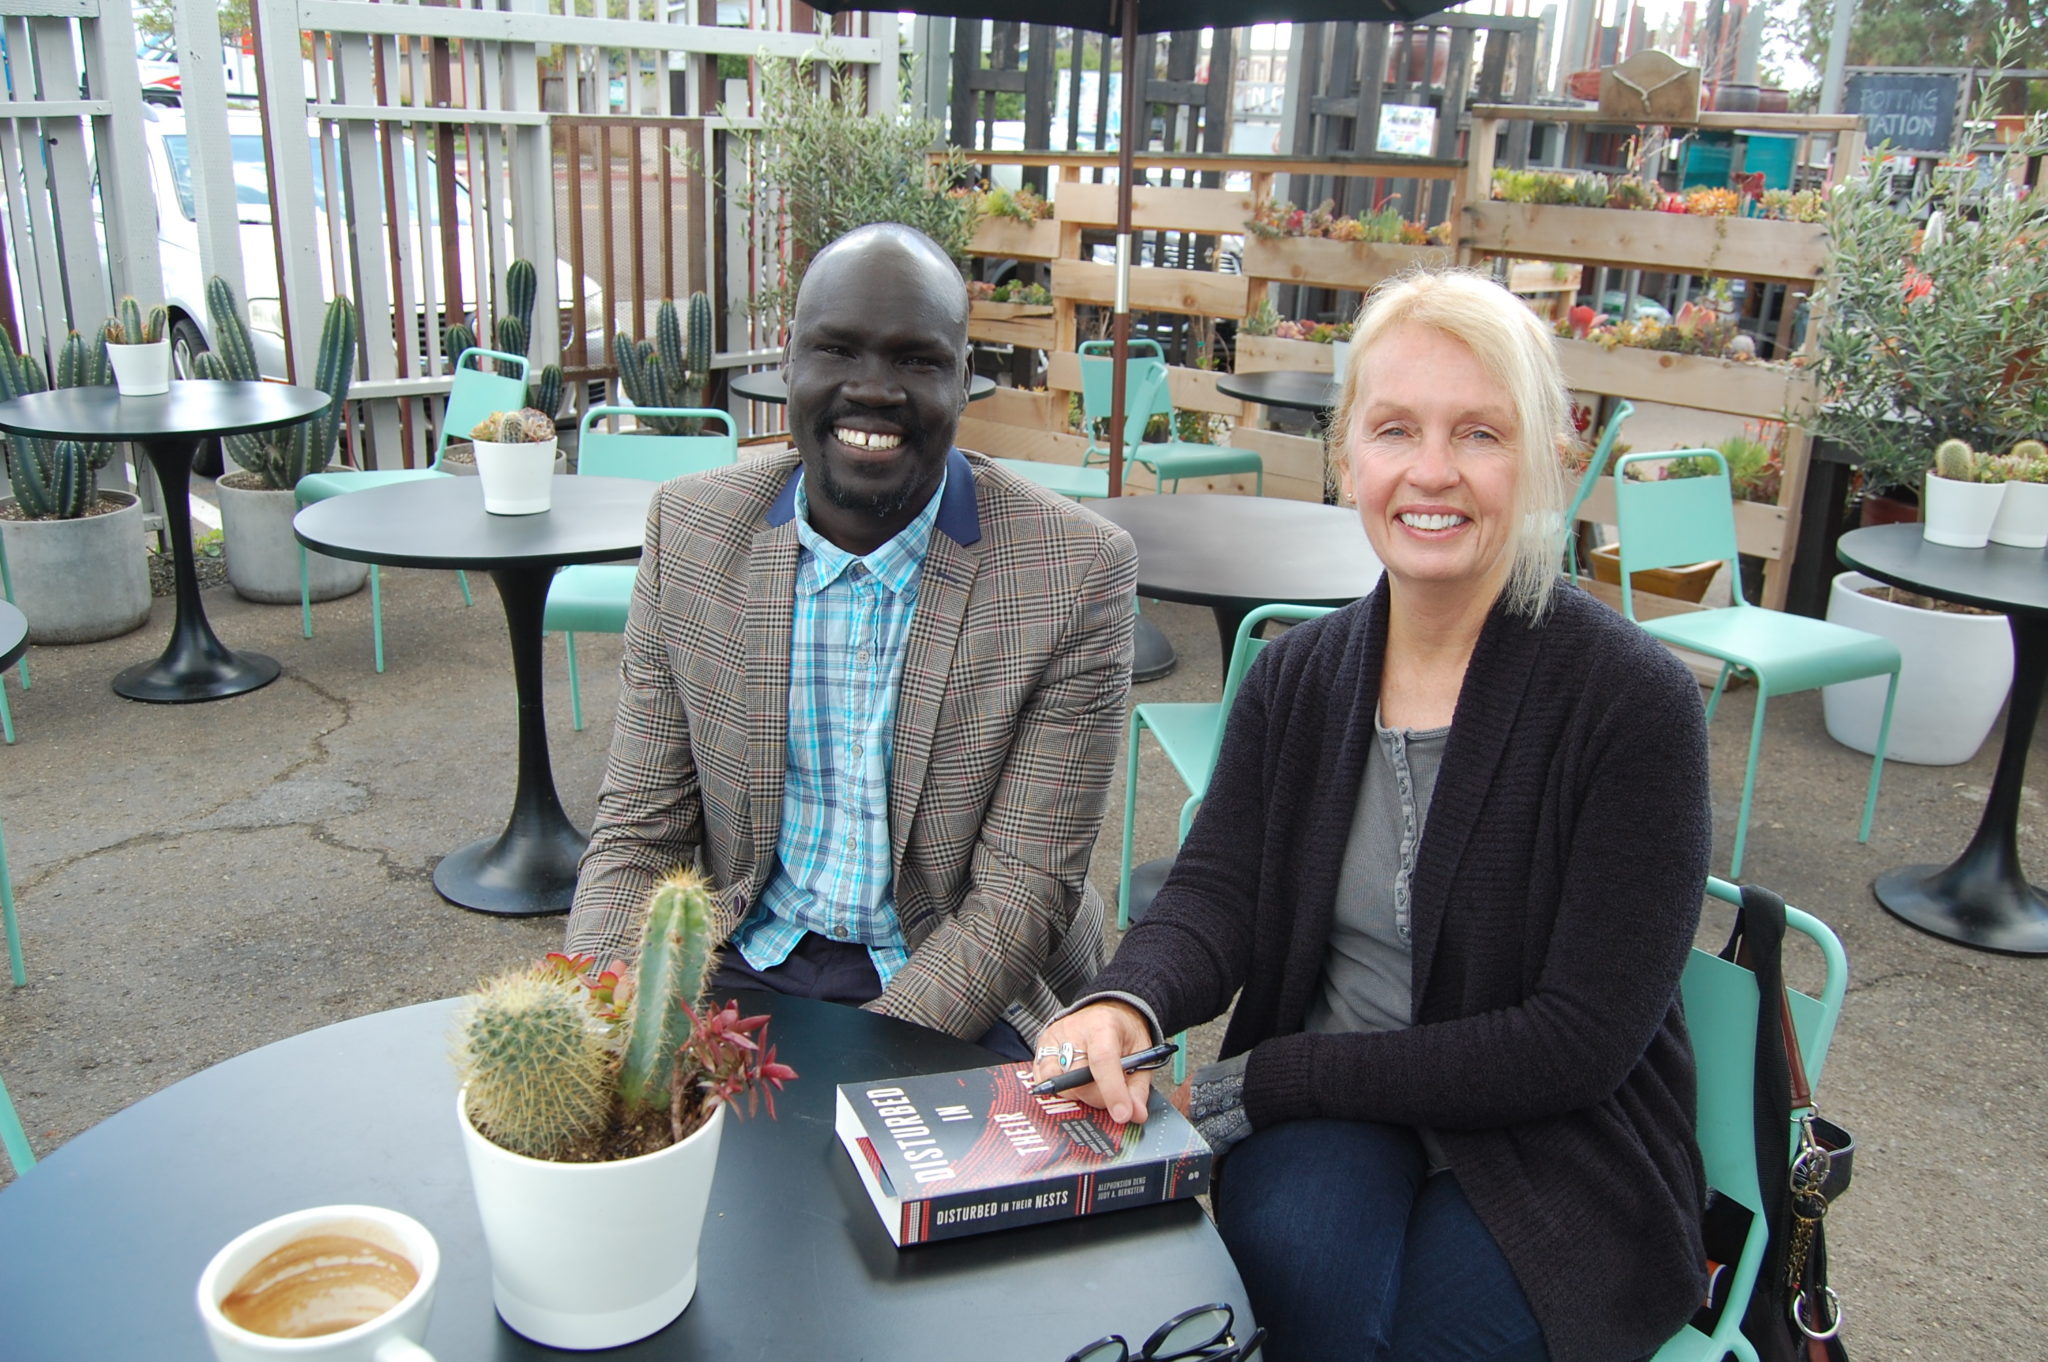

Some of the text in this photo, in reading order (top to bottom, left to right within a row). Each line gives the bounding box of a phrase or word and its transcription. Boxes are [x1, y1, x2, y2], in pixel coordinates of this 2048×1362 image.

[1863, 113, 1937, 137] TATION
[935, 1105, 974, 1122] IN
[866, 1087, 956, 1184] DISTURBED
[994, 1112, 1050, 1157] THEIR
[936, 1190, 1069, 1225] DISTURBED IN THEIR NESTS
